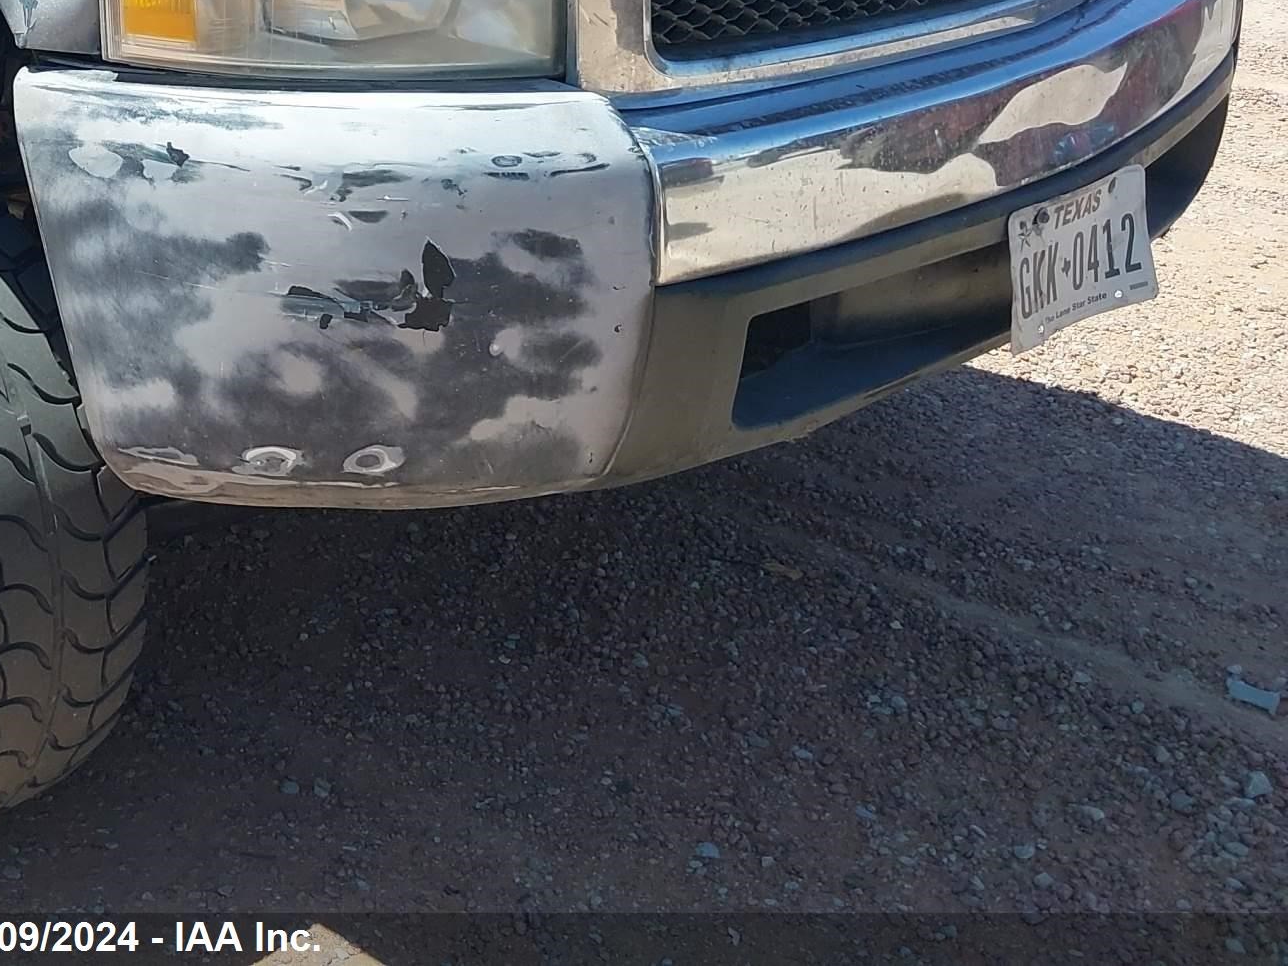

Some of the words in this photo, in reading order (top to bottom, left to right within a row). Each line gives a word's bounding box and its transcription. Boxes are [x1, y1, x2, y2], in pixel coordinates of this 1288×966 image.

[1054, 189, 1101, 230] TEXAS
[1019, 242, 1059, 319] GKK
[1073, 212, 1142, 291] 0412
[1087, 292, 1108, 305] State
